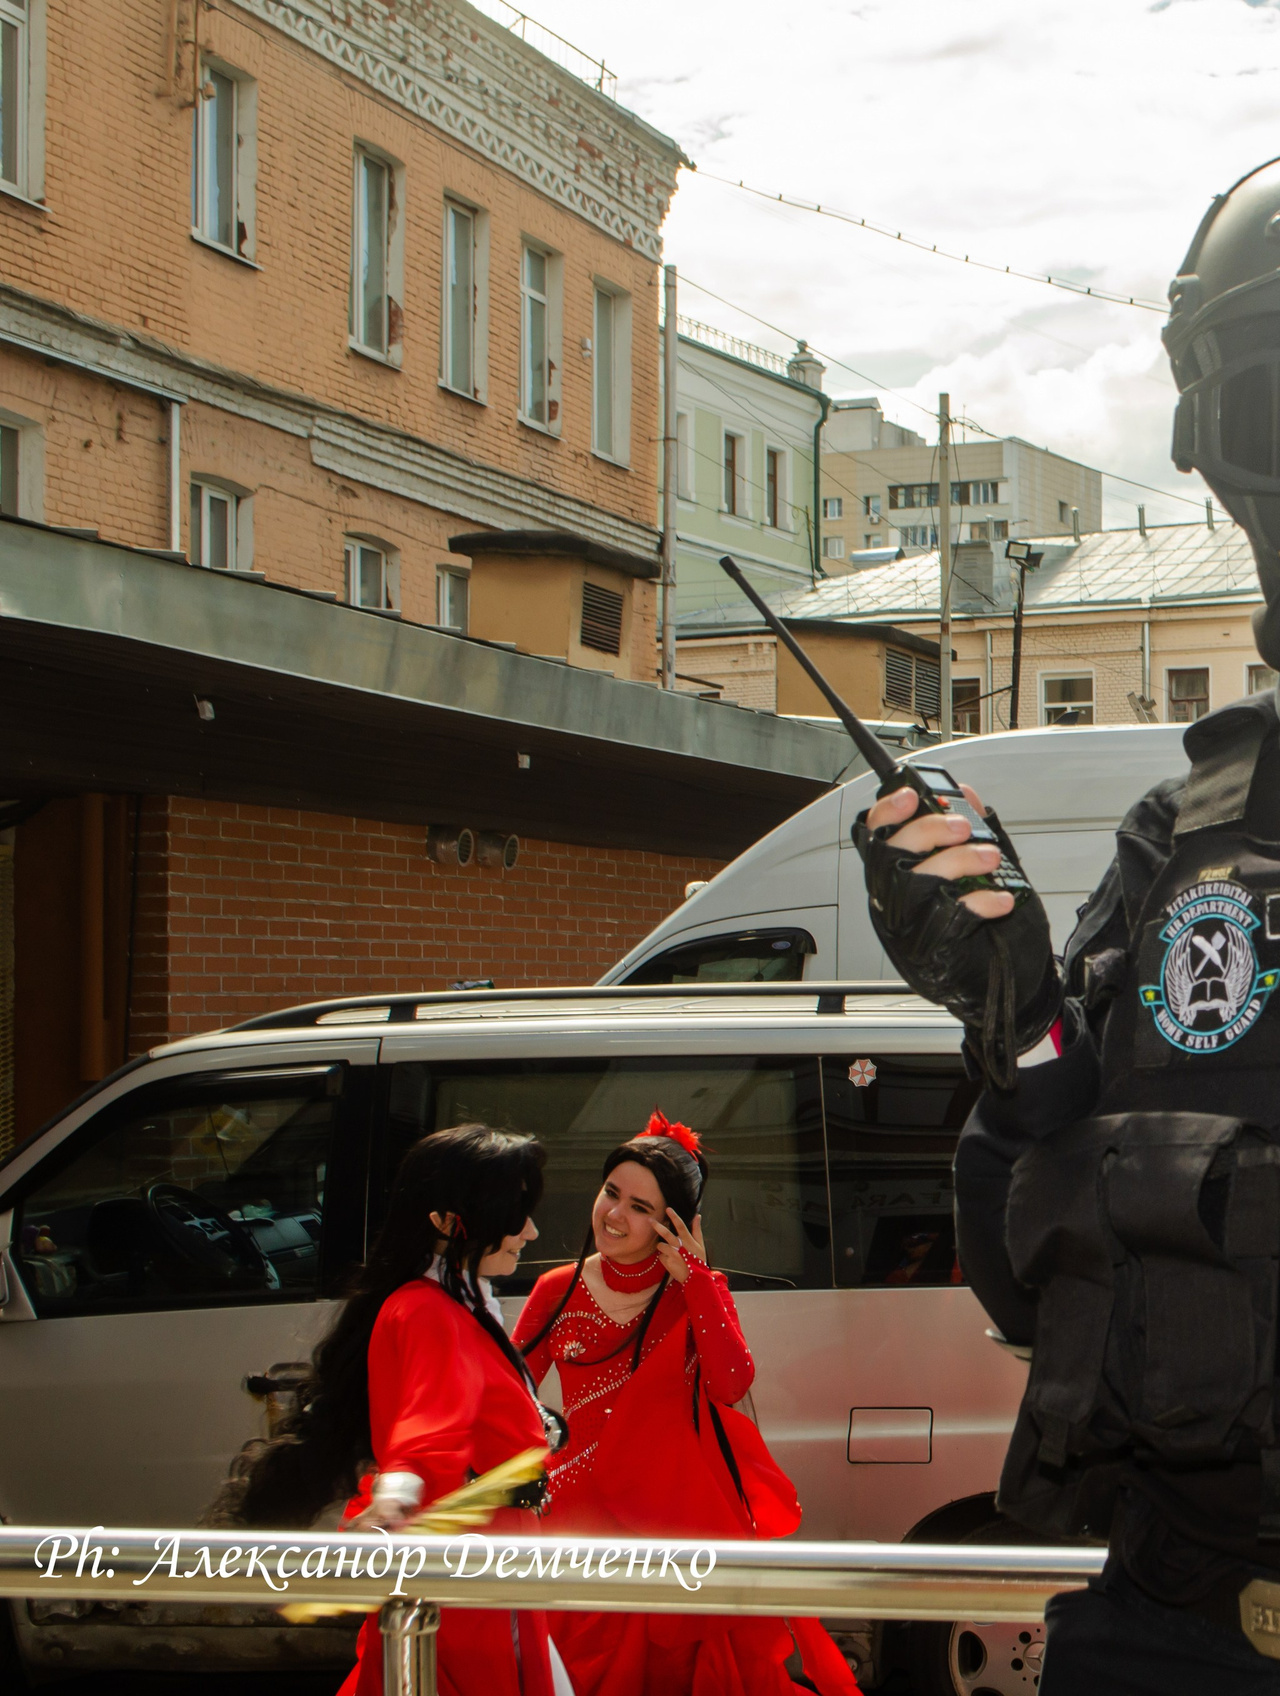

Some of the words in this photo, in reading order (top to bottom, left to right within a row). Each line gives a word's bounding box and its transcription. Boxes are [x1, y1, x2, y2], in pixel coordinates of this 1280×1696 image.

[1166, 918, 1184, 939] HR
[1181, 900, 1252, 928] DEPARTMENT
[1157, 1008, 1185, 1042] HOME
[1186, 1035, 1219, 1049] SELF
[1224, 998, 1262, 1041] GUARD
